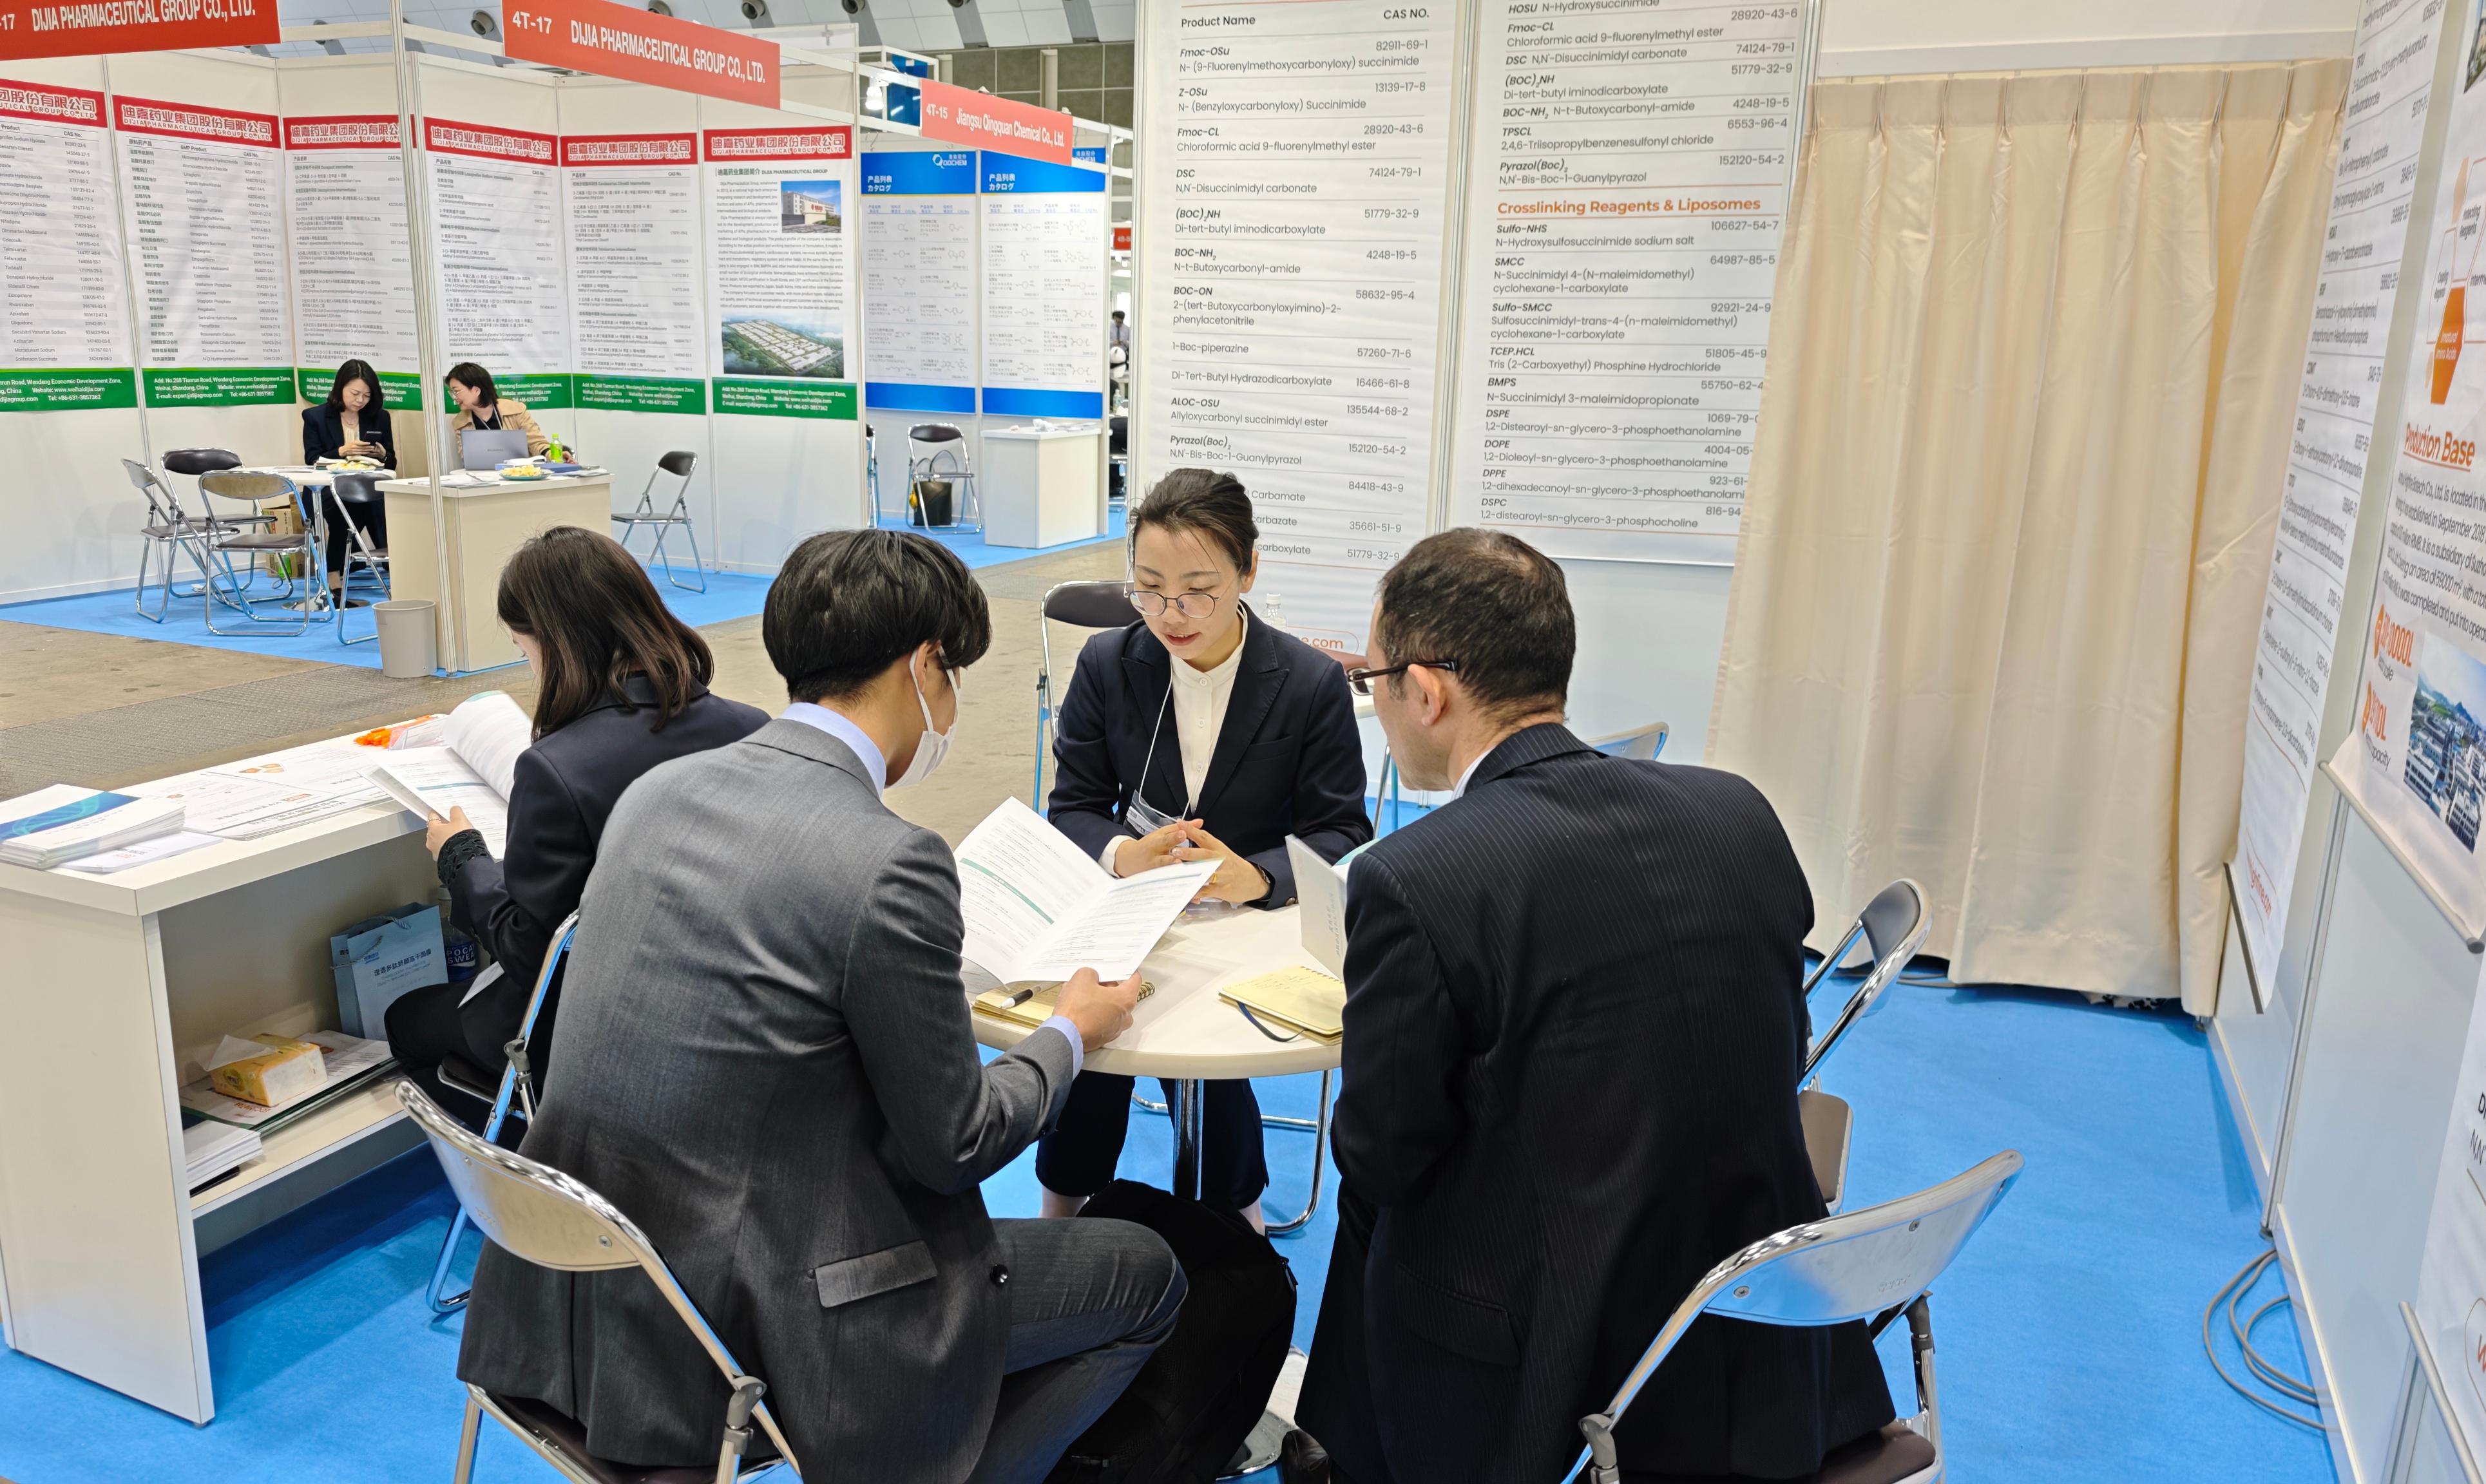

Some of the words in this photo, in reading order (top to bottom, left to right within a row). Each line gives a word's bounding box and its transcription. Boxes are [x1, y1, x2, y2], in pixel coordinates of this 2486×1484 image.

[1384, 9, 1406, 19] CAS
[1410, 8, 1429, 19] NO.
[1509, 3, 1538, 14] HOSU
[32, 6, 59, 31] DIJIA
[61, 0, 159, 29] PHARMACEUTICAL
[160, 0, 200, 22] GROUP
[203, 0, 227, 22] CO.,
[231, 0, 256, 17] LTD.
[1732, 8, 1797, 21] 28920-43-6
[1181, 17, 1220, 28] Product
[1223, 16, 1256, 25] Name
[1507, 22, 1554, 33] Fmoc-CL
[1507, 35, 1572, 47] Chloroformic
[1575, 33, 1598, 43] acid
[1601, 28, 1694, 43] 9-fluorenylmethyl
[1697, 28, 1723, 37] ester
[512, 10, 552, 35] 4T-17
[571, 20, 598, 48] DIJIA
[600, 26, 692, 68] PHARMACEUTICAL
[693, 48, 725, 75] GROUP
[727, 57, 745, 81] CO.,
[747, 62, 765, 84] LTD.
[1376, 39, 1428, 51] 82911-69-1
[1737, 43, 1794, 53] 74124-79-1
[1180, 46, 1230, 57] Fmoc-OSu
[1506, 55, 1527, 65] DSC
[1532, 51, 1629, 64] N,N'-Disuccinimidyl
[1632, 49, 1687, 59] carbonate
[1180, 64, 1190, 72] N-
[1194, 56, 1355, 73] (9-Fluorenylmethoxycarbonyloxy)
[1359, 56, 1419, 67] succinimide
[1732, 63, 1792, 75] 51779-32-9
[1179, 88, 1207, 97] Z-OSu
[1376, 82, 1426, 92] 13139-17-8
[1504, 88, 1565, 99] Di-tert-butyl
[1569, 85, 1668, 97] iminodicarboxylate
[1179, 103, 1189, 111] N-
[1192, 98, 1303, 113] (Benzyloxycarbonyloxy)
[1306, 99, 1366, 109] Succinimide
[1554, 101, 1695, 116] N-t-Butoxycarbonyl-amide
[1733, 98, 1789, 108] 4248-19-5
[122, 106, 272, 135] 迪嘉药业集团股份有限公司
[926, 104, 948, 120] 4T-15
[956, 108, 982, 132] Jiangsu
[983, 114, 1013, 138] Qingquan
[1013, 120, 1040, 142] Chemical
[1041, 127, 1053, 146] Co.,
[1054, 133, 1065, 147] Ltd.
[1728, 119, 1787, 129] 6553-96-4
[1178, 128, 1219, 137] Fmoc-CL
[1364, 124, 1423, 135] 28920-43-6
[1503, 127, 1531, 137] TPSCL
[431, 127, 551, 153] 迪嘉药业集团股份有限公司
[712, 135, 845, 149] 迪嘉药业集团股份有限公司
[1502, 137, 1668, 151] 2,4,6-Triisopropylbenzenesulfonyl
[1671, 135, 1714, 145] chloride
[568, 141, 690, 154] 迪嘉药业集团股份有限公司
[1177, 142, 1236, 151] Chloroformic
[1239, 142, 1259, 151] acid
[1263, 141, 1349, 153] 9-fluorenylmethyl
[1352, 141, 1376, 150] ester
[1720, 155, 1784, 165] 152120-54-2
[717, 167, 760, 176] 迪嘉药业集团简介
[1176, 169, 1195, 178] DSC
[1370, 167, 1420, 177] 74124-79-1
[867, 175, 892, 184] 产品列表
[989, 174, 1016, 183] 产品列表
[989, 183, 1015, 191] カタログ
[1176, 183, 1263, 195] N,N'-Disuccinimidyl
[1266, 184, 1317, 193] carbonate
[1498, 200, 1585, 215] Crosslinking
[1591, 201, 1659, 214] Reagents
[1664, 200, 1673, 211] &
[1679, 198, 1760, 213] Liposomes
[1365, 209, 1419, 218] 51779-32-9
[1176, 224, 1231, 236] Di-tert-butyl
[1234, 224, 1325, 236] iminodicarboxylate
[1496, 224, 1547, 233] Sulfo-NHS
[1712, 221, 1778, 230] 106627-54-7
[1496, 236, 1632, 249] N-Hydroxysulfosuccinimide
[1635, 236, 1672, 245] sodium
[1676, 236, 1694, 245] salt
[1366, 251, 1416, 260] 4248-19-5
[1710, 255, 1775, 265] 64987-85-5
[1495, 258, 1525, 266] SMCC
[1174, 263, 1301, 275] N-t-Butoxycarbonyl-amide
[1495, 271, 1568, 281] N-Succinimidyl
[1571, 267, 1694, 281] 4-(N-maleimidomethyl)
[1174, 287, 1212, 296] BOC-ON
[1493, 283, 1628, 295] cyclohexane-1-carboxylate
[1356, 290, 1414, 300] 58632-95-4
[1174, 299, 1341, 314] 2-(tert-Butoxycarbonyloxyimino)-2-
[1493, 303, 1553, 312] Sulfo-SMCC
[1711, 303, 1770, 312] 92921-24-9
[1173, 315, 1254, 326] phenylacetonitrile
[1491, 330, 1625, 341] cyclohexane-1-carboxylate
[1173, 342, 1248, 354] 1-Boc-piperazine
[1357, 348, 1411, 358] 57260-71-6
[1491, 347, 1535, 356] TCEP.HCL
[1706, 349, 1766, 358] 51805-45-9
[1489, 360, 1504, 368] Tris
[1508, 358, 1591, 372] (2-Carboxyethyl)
[1594, 361, 1646, 372] Phosphine
[1649, 362, 1721, 373] Hydrochloride
[1172, 371, 1228, 383] Di-Tert-Butyl
[1231, 374, 1332, 387] Hydrazodicarboxylate
[1357, 378, 1409, 388] 16466-61-8
[1487, 377, 1516, 386] BMPS
[1171, 397, 1219, 407] ALOC-OSU
[1487, 393, 1565, 405] N-Succinimidyl
[1569, 394, 1699, 407] 3-maleimidopropionate
[1347, 405, 1408, 415] 135544-68-2
[1486, 409, 1510, 417] DSPE
[1171, 412, 1242, 424] Allyloxycarbonyl
[1245, 415, 1302, 428] succinimidyl
[1349, 444, 1406, 455] 152120-54-2
[1484, 440, 1510, 448] DOPE
[2405, 422, 2440, 461] Production
[2442, 430, 2475, 466] Base
[1483, 469, 1506, 477] DPPE
[1349, 481, 1403, 492] 84418-43-9
[1252, 490, 1305, 501] Carbamate
[1482, 498, 1507, 506] DSPC
[1350, 521, 1401, 533] 35661-51-9
[2438, 517, 2472, 538] September
[2472, 523, 2485, 539] 2018
[1348, 549, 1399, 560] 51779-32-9
[447, 946, 473, 956] POCA
[448, 953, 475, 964] SWEA
